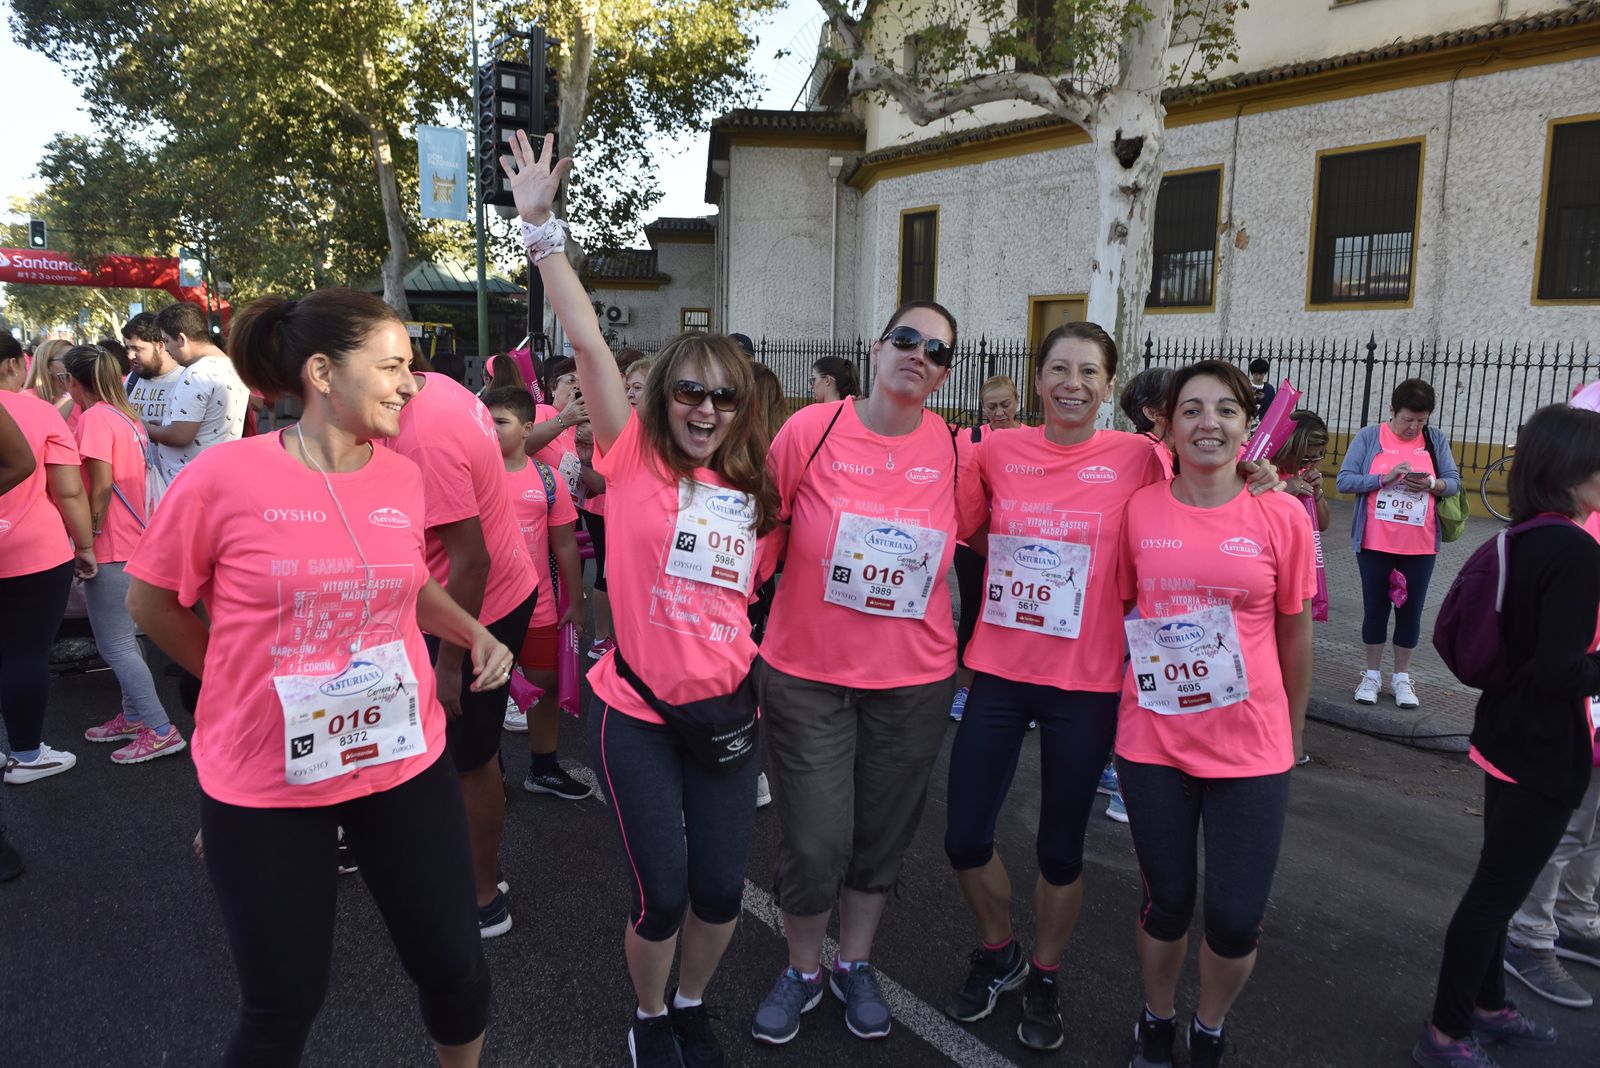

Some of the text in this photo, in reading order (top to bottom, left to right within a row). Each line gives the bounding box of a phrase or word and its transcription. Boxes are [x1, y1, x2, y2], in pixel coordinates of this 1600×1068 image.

[831, 460, 875, 476] OYSHO
[1004, 463, 1045, 477] OYSHO
[1391, 499, 1413, 510] 016
[263, 508, 327, 523] OYSHO
[708, 531, 745, 556] 016
[869, 534, 914, 552] ASTURIANA
[1140, 538, 1183, 550] OYSHO
[715, 554, 735, 567] 5986
[1016, 553, 1057, 567] ASTURIANA
[862, 564, 906, 586] 016
[323, 580, 359, 592] VITORIA
[869, 585, 892, 597] 3989
[1011, 580, 1051, 602] 016
[1018, 601, 1039, 612] 5617
[709, 622, 739, 644] 2019
[1158, 631, 1201, 644] ASTURIANA
[1164, 660, 1209, 682] 016
[326, 669, 381, 693] ASTURIANA
[1177, 682, 1202, 693] 4695
[328, 704, 382, 736] 016
[339, 730, 369, 747] 8372
[391, 743, 416, 755] ZURICH
[293, 760, 329, 778] OYSHO
